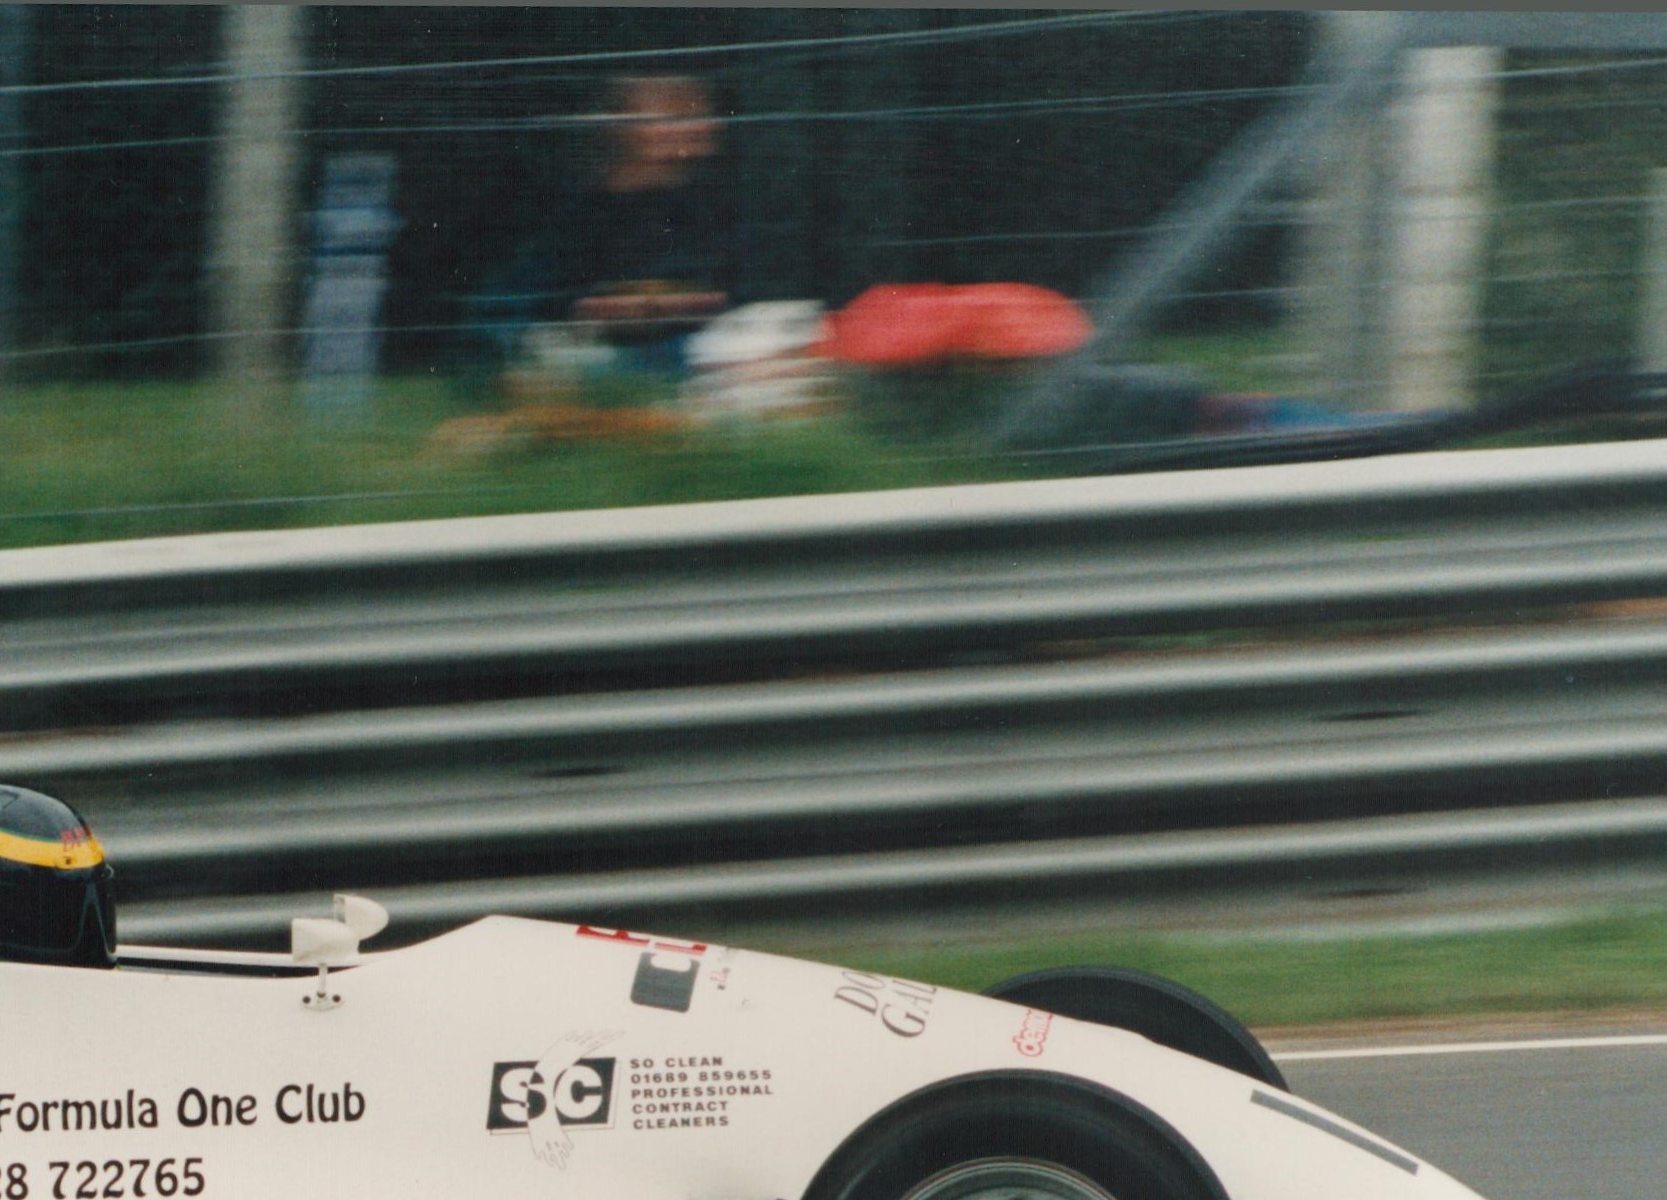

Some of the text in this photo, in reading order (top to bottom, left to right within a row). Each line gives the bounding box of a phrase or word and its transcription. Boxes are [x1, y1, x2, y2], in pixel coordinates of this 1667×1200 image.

[630, 1056, 723, 1069] SO CLEAN
[630, 1071, 688, 1085] 01689
[631, 1084, 774, 1099] PROFESSIONAL
[176, 1085, 259, 1128] One
[274, 1081, 367, 1125] Club
[632, 1100, 729, 1115] CONTRACT
[632, 1115, 730, 1130] CLEANERS
[49, 1156, 206, 1200] 722765
